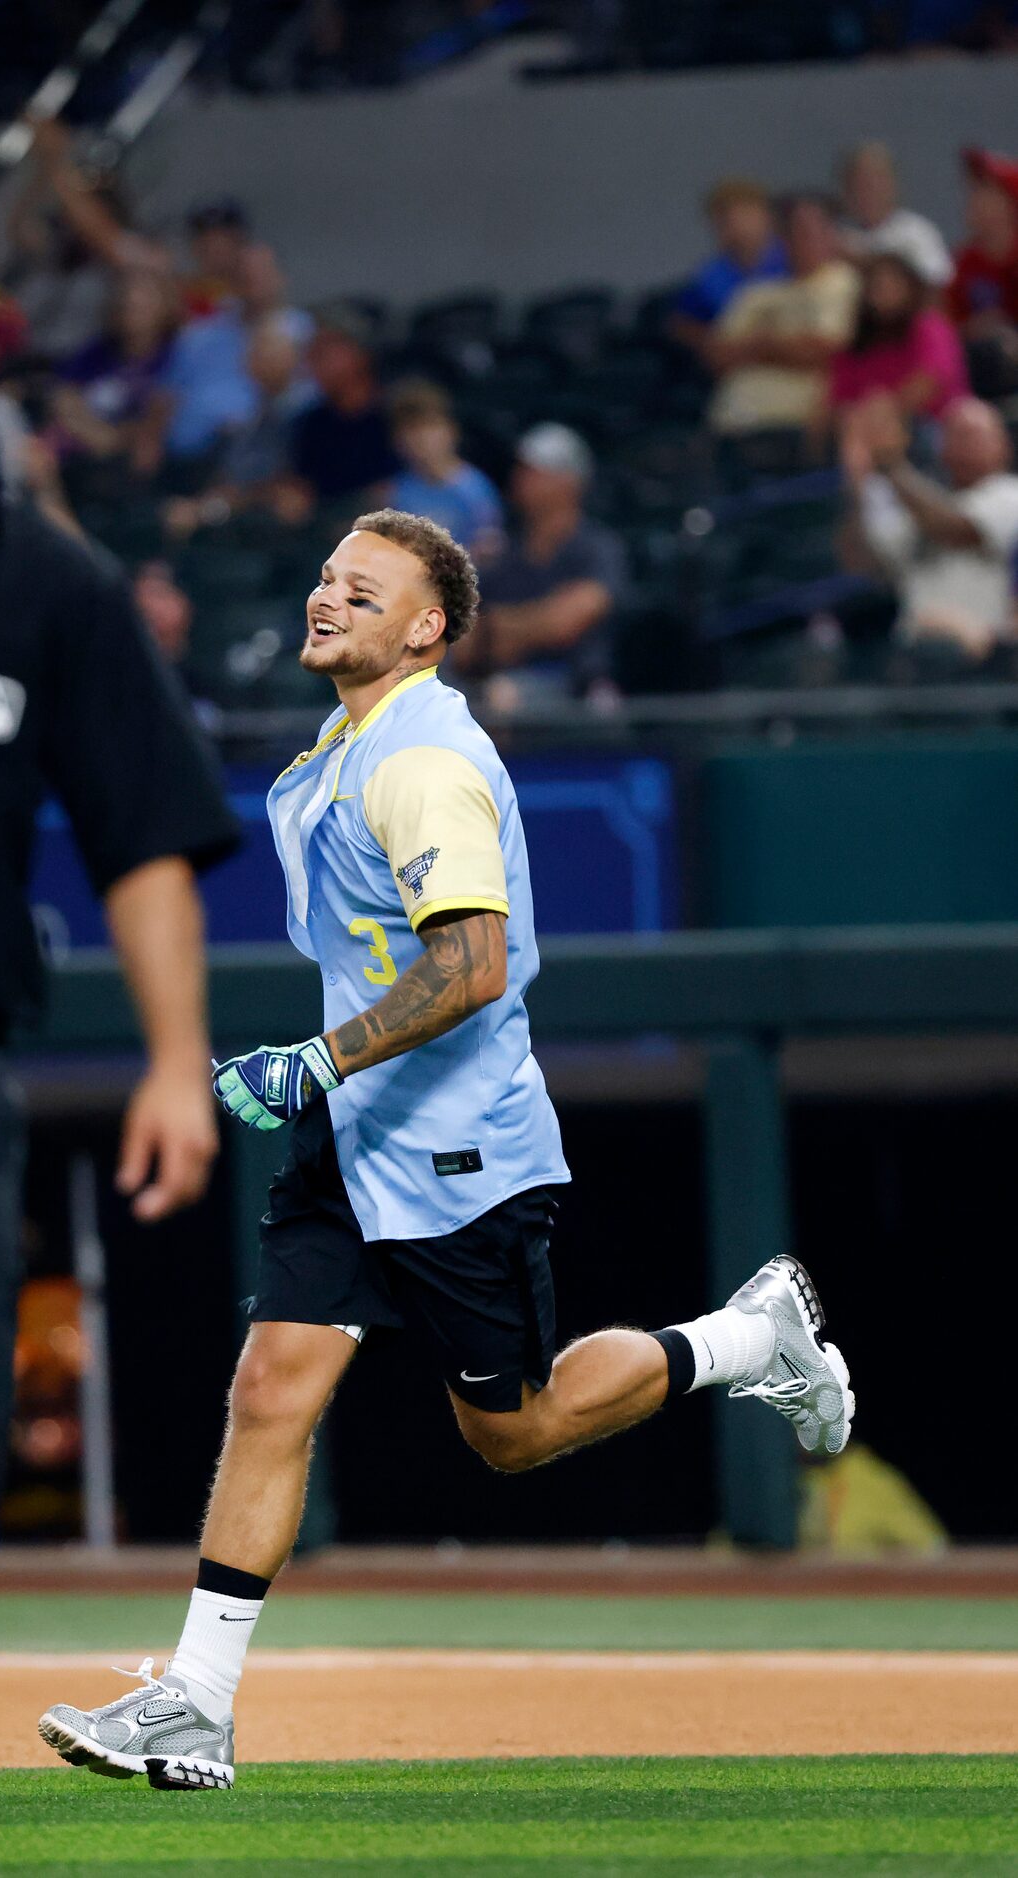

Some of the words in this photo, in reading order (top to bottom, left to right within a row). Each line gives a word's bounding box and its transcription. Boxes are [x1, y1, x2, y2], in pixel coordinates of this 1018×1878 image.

[402, 858, 433, 884] CELEBRITY
[349, 918, 398, 985] 3
[467, 1157, 473, 1165] L
